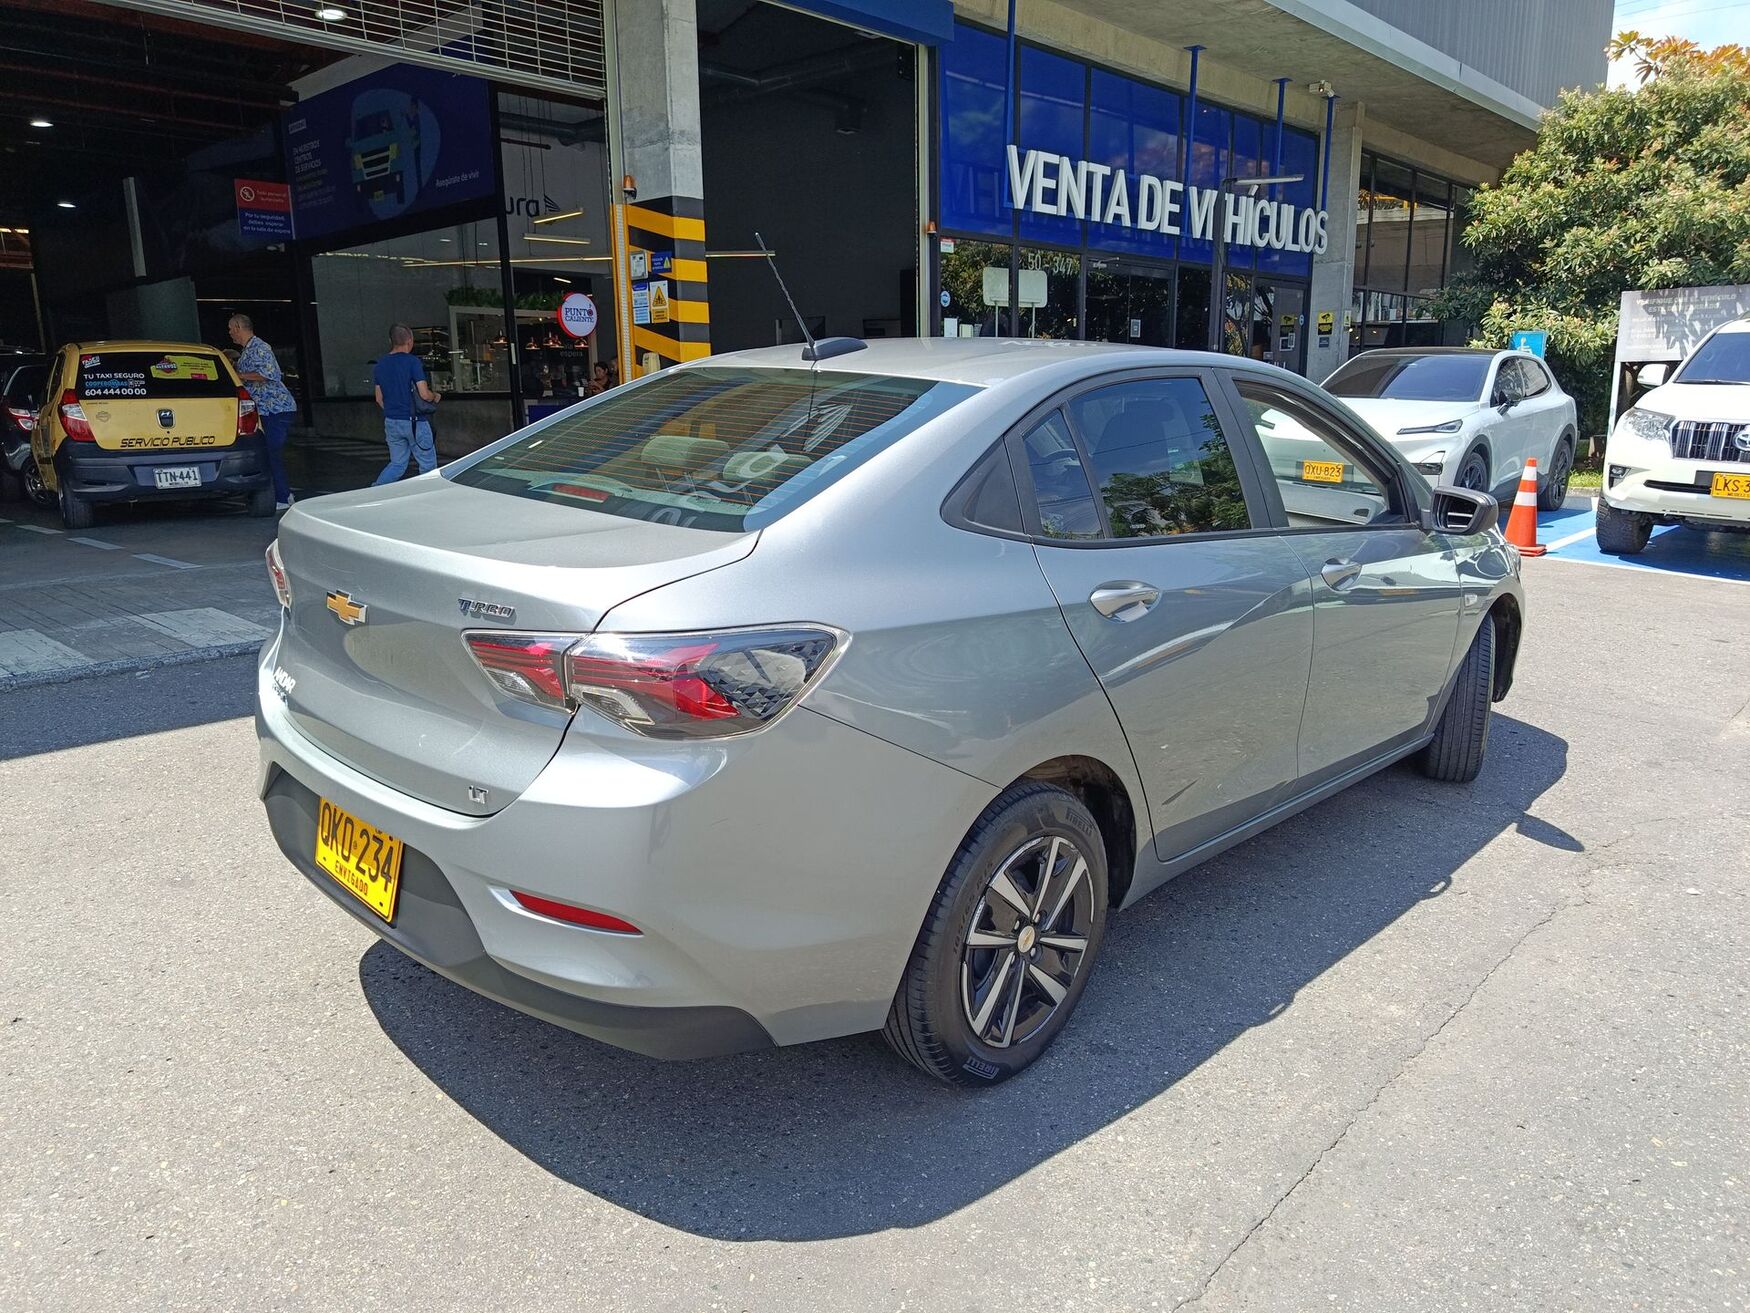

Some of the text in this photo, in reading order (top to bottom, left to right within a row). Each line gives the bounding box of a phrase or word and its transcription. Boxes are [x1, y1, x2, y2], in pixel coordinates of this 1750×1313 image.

[1006, 144, 1131, 228] VENTA
[1137, 174, 1183, 236] DE
[1028, 253, 1041, 270] 50
[565, 307, 593, 317] PUNTO
[85, 388, 102, 396] 604
[120, 438, 169, 448] SERVICIO
[468, 785, 489, 804] LT
[334, 860, 369, 896] ENVIGADO
[962, 1056, 1001, 1080] PIRELLI
